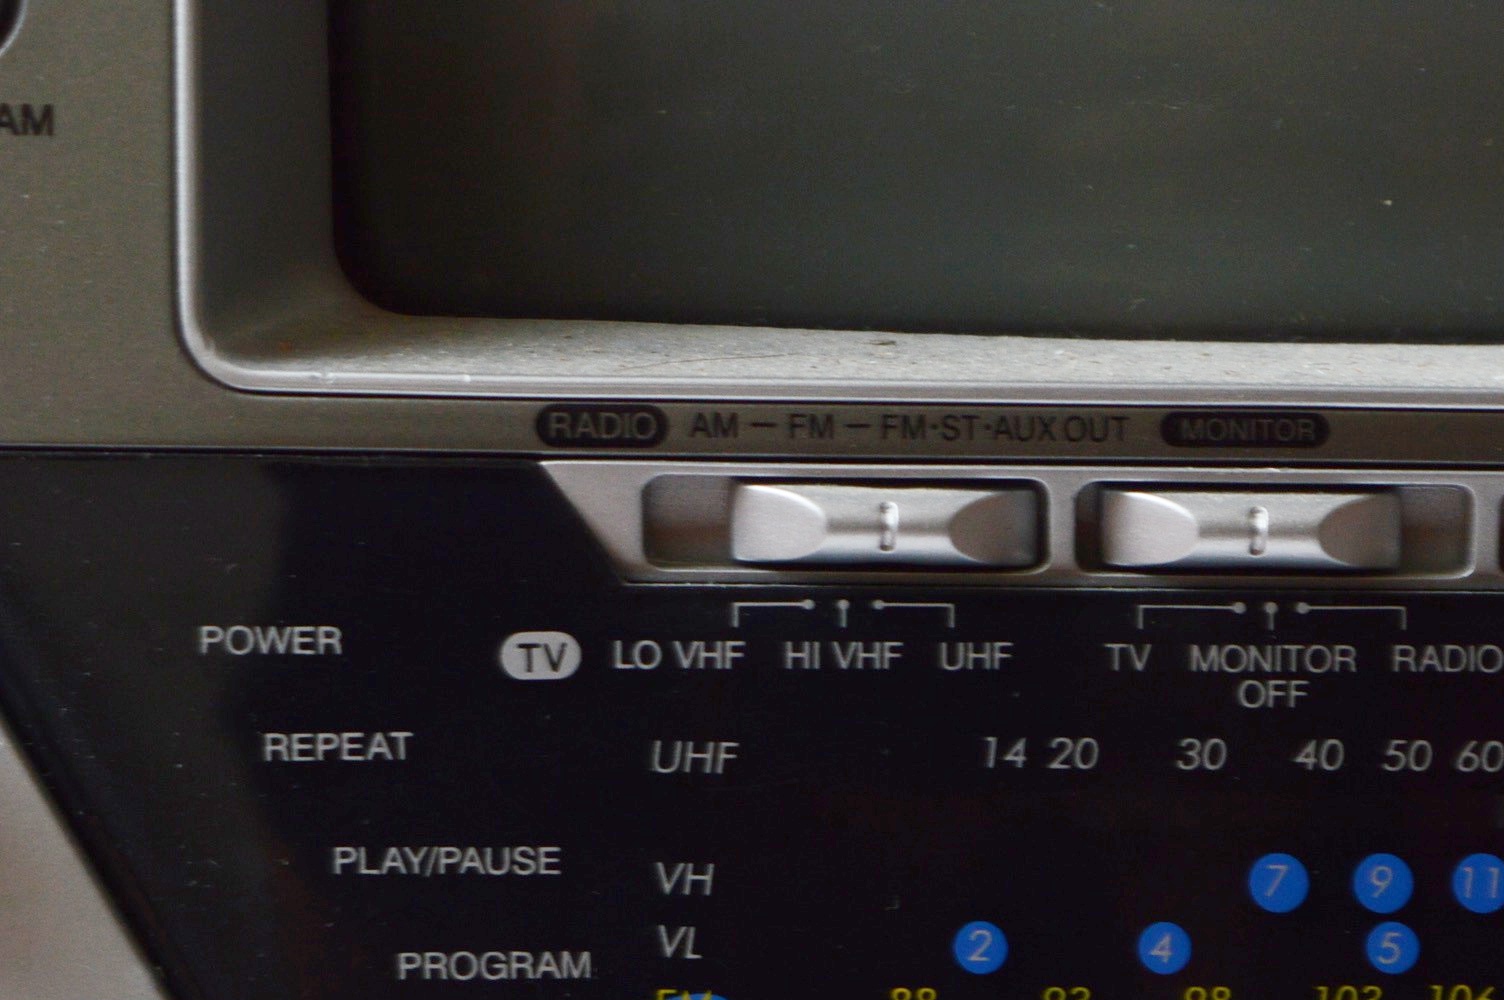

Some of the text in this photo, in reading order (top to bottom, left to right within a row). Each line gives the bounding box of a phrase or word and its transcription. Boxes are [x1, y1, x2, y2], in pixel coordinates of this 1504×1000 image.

[549, 411, 657, 440] RADIO
[687, 412, 739, 439] AM
[786, 413, 835, 440] FM
[1065, 415, 1130, 444] OUT
[1178, 414, 1317, 442] MONITOR
[199, 624, 342, 656] POWER
[613, 639, 746, 670] LO VHF
[784, 641, 904, 670] HI VHF
[516, 642, 567, 673] TV
[940, 641, 1014, 671] UHF
[1104, 642, 1152, 672] TV
[1189, 643, 1356, 674] MONITOR
[1392, 644, 1504, 674] RADIO
[1237, 679, 1309, 709] OFF
[263, 731, 414, 762] REPEAT
[652, 740, 740, 774] UHF
[985, 736, 1027, 769] 14
[1048, 736, 1099, 770] 20
[1176, 737, 1227, 771] 30
[1293, 738, 1344, 771] 40
[1382, 739, 1433, 772] 50
[333, 845, 561, 876] PLAY/PAUSE
[656, 861, 715, 896] VH
[1264, 863, 1289, 897] 7
[1369, 865, 1393, 898] 9
[1462, 865, 1500, 899] 11
[658, 924, 702, 960] VL
[967, 929, 993, 962] 2
[1149, 933, 1173, 963] 4
[1377, 931, 1402, 965] 5
[397, 950, 591, 981] PROGRAM
